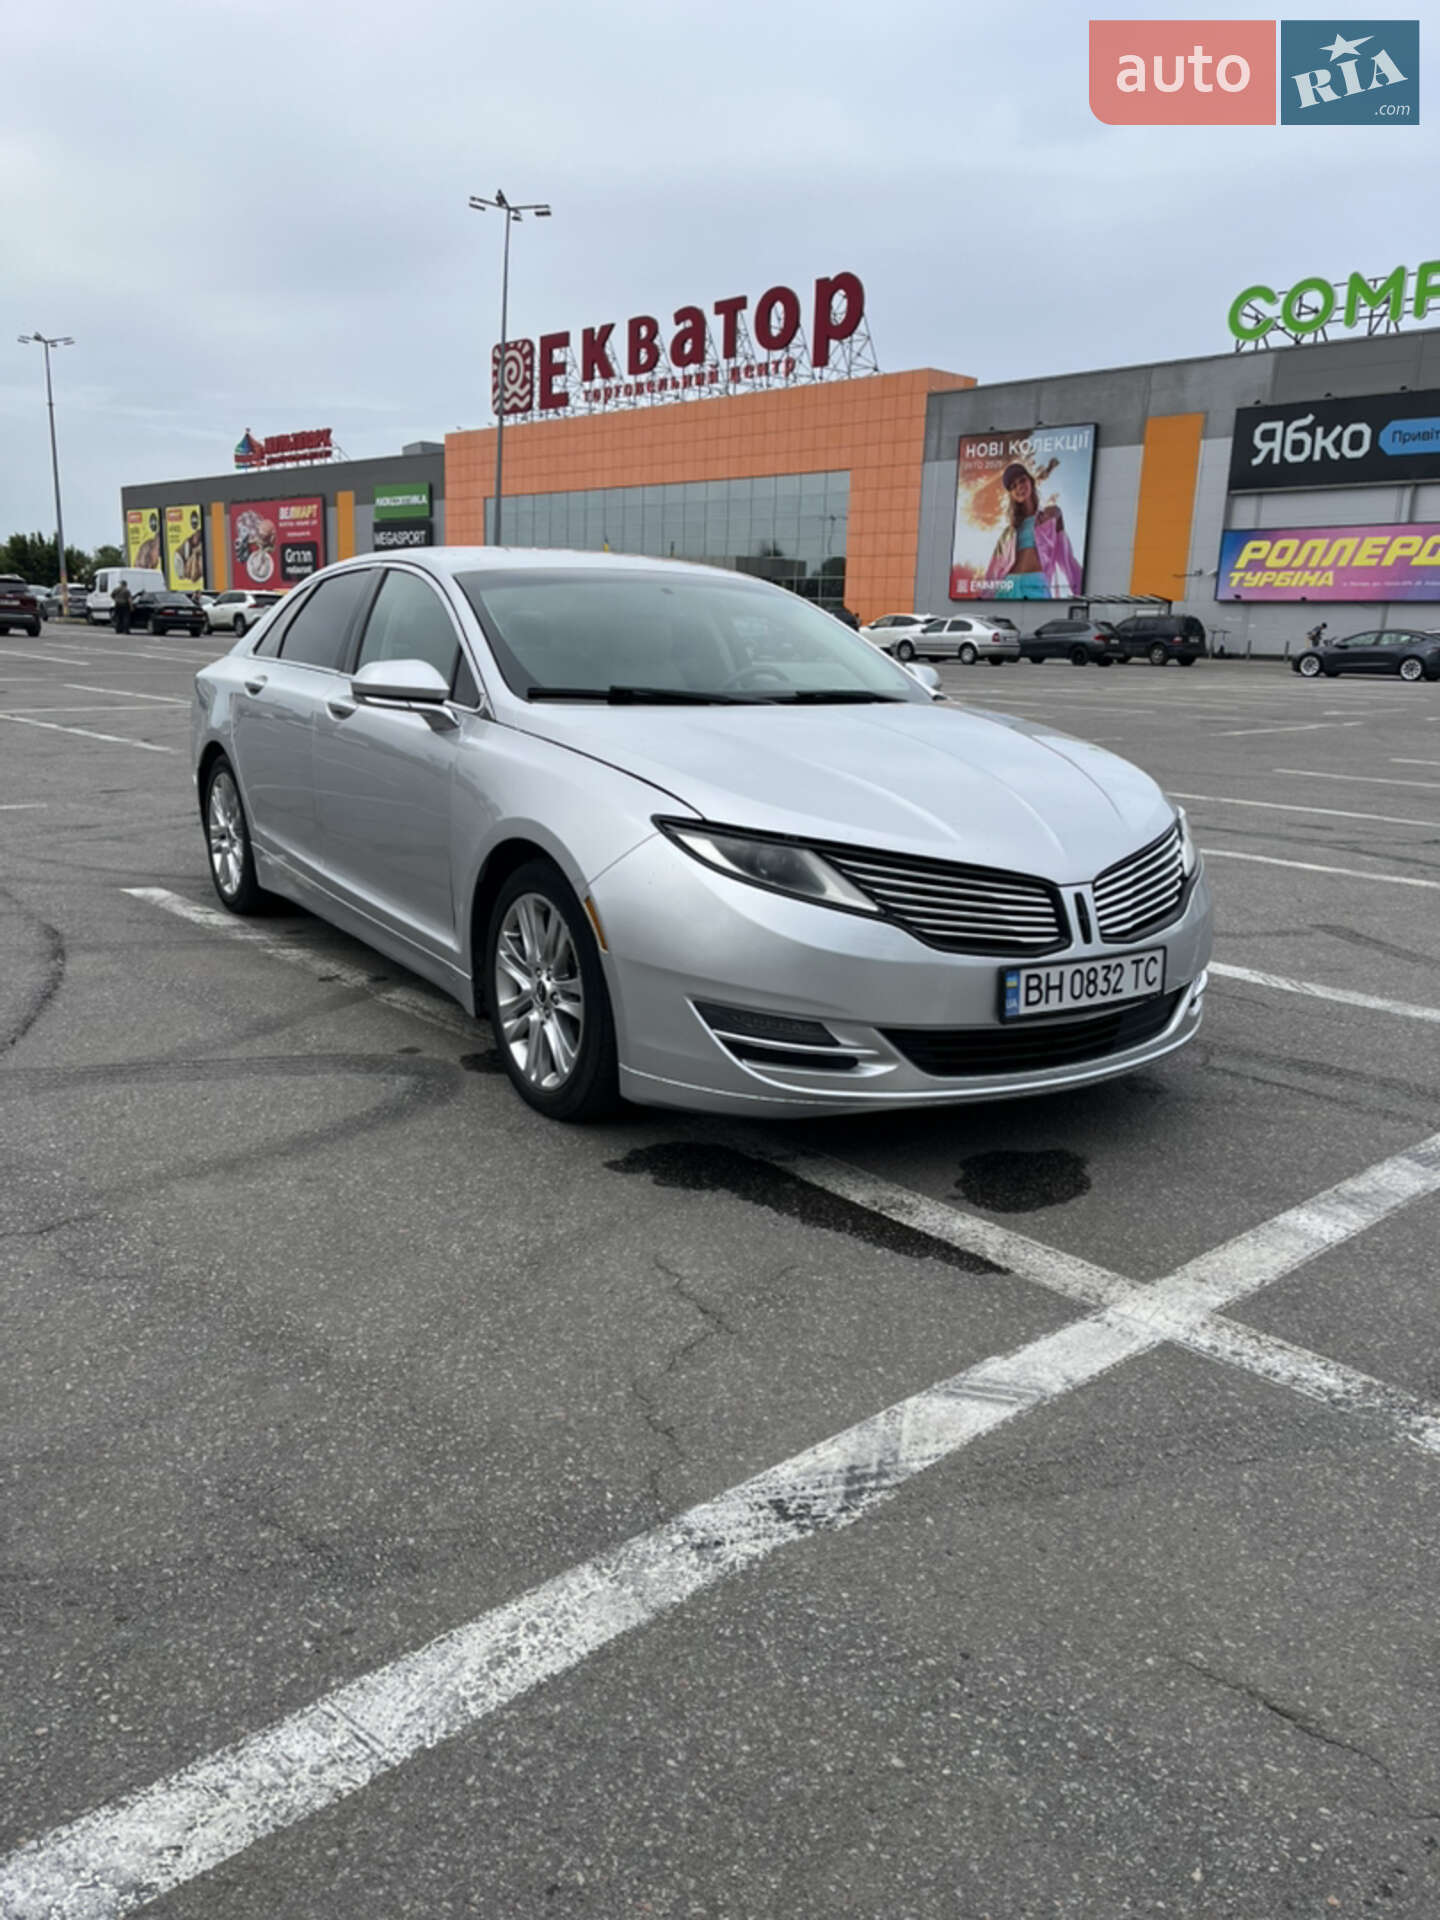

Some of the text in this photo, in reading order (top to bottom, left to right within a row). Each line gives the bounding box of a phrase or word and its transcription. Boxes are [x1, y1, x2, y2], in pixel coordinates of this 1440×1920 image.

[965, 442, 1004, 459] НОВІ
[1229, 570, 1335, 588] ТУРБІНА
[1025, 956, 1158, 1007] BH 0832 TC
